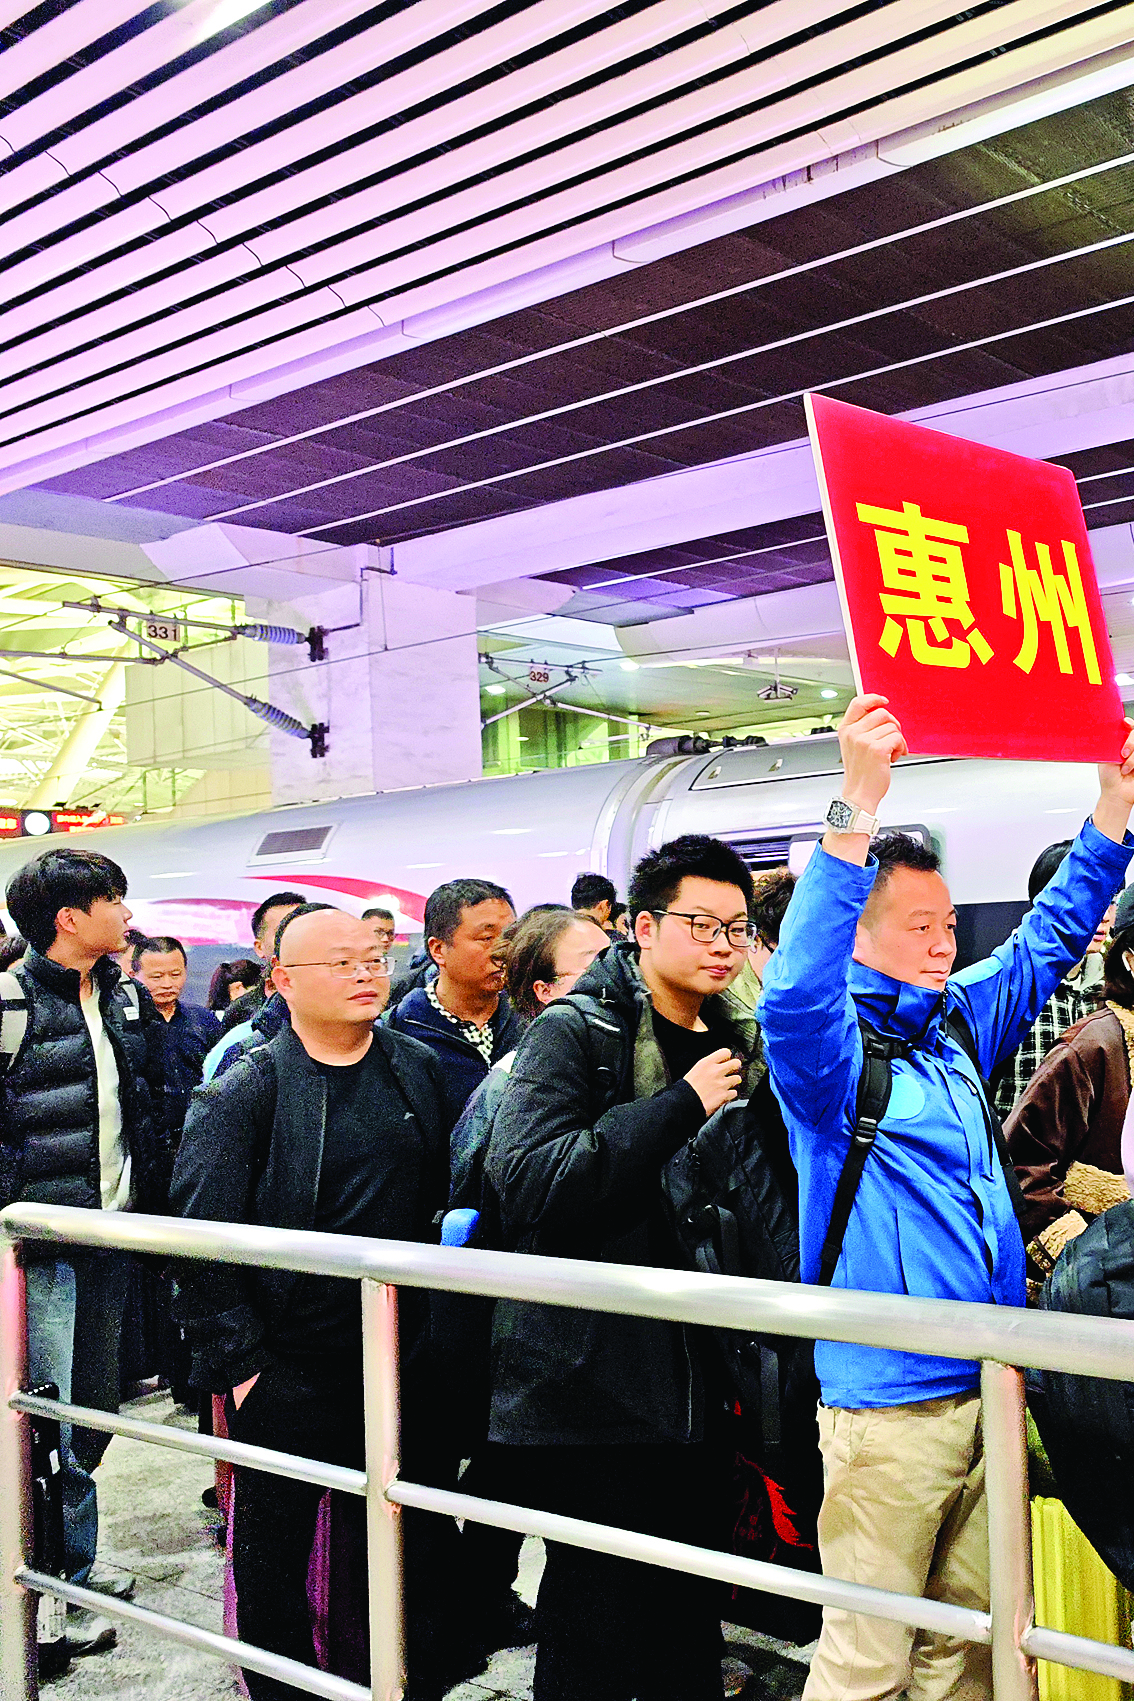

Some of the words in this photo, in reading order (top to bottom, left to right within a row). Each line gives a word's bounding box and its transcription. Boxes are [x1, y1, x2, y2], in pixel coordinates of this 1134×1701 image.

[855, 500, 1102, 686] 惠州
[147, 624, 178, 641] 331
[529, 670, 550, 683] 329
